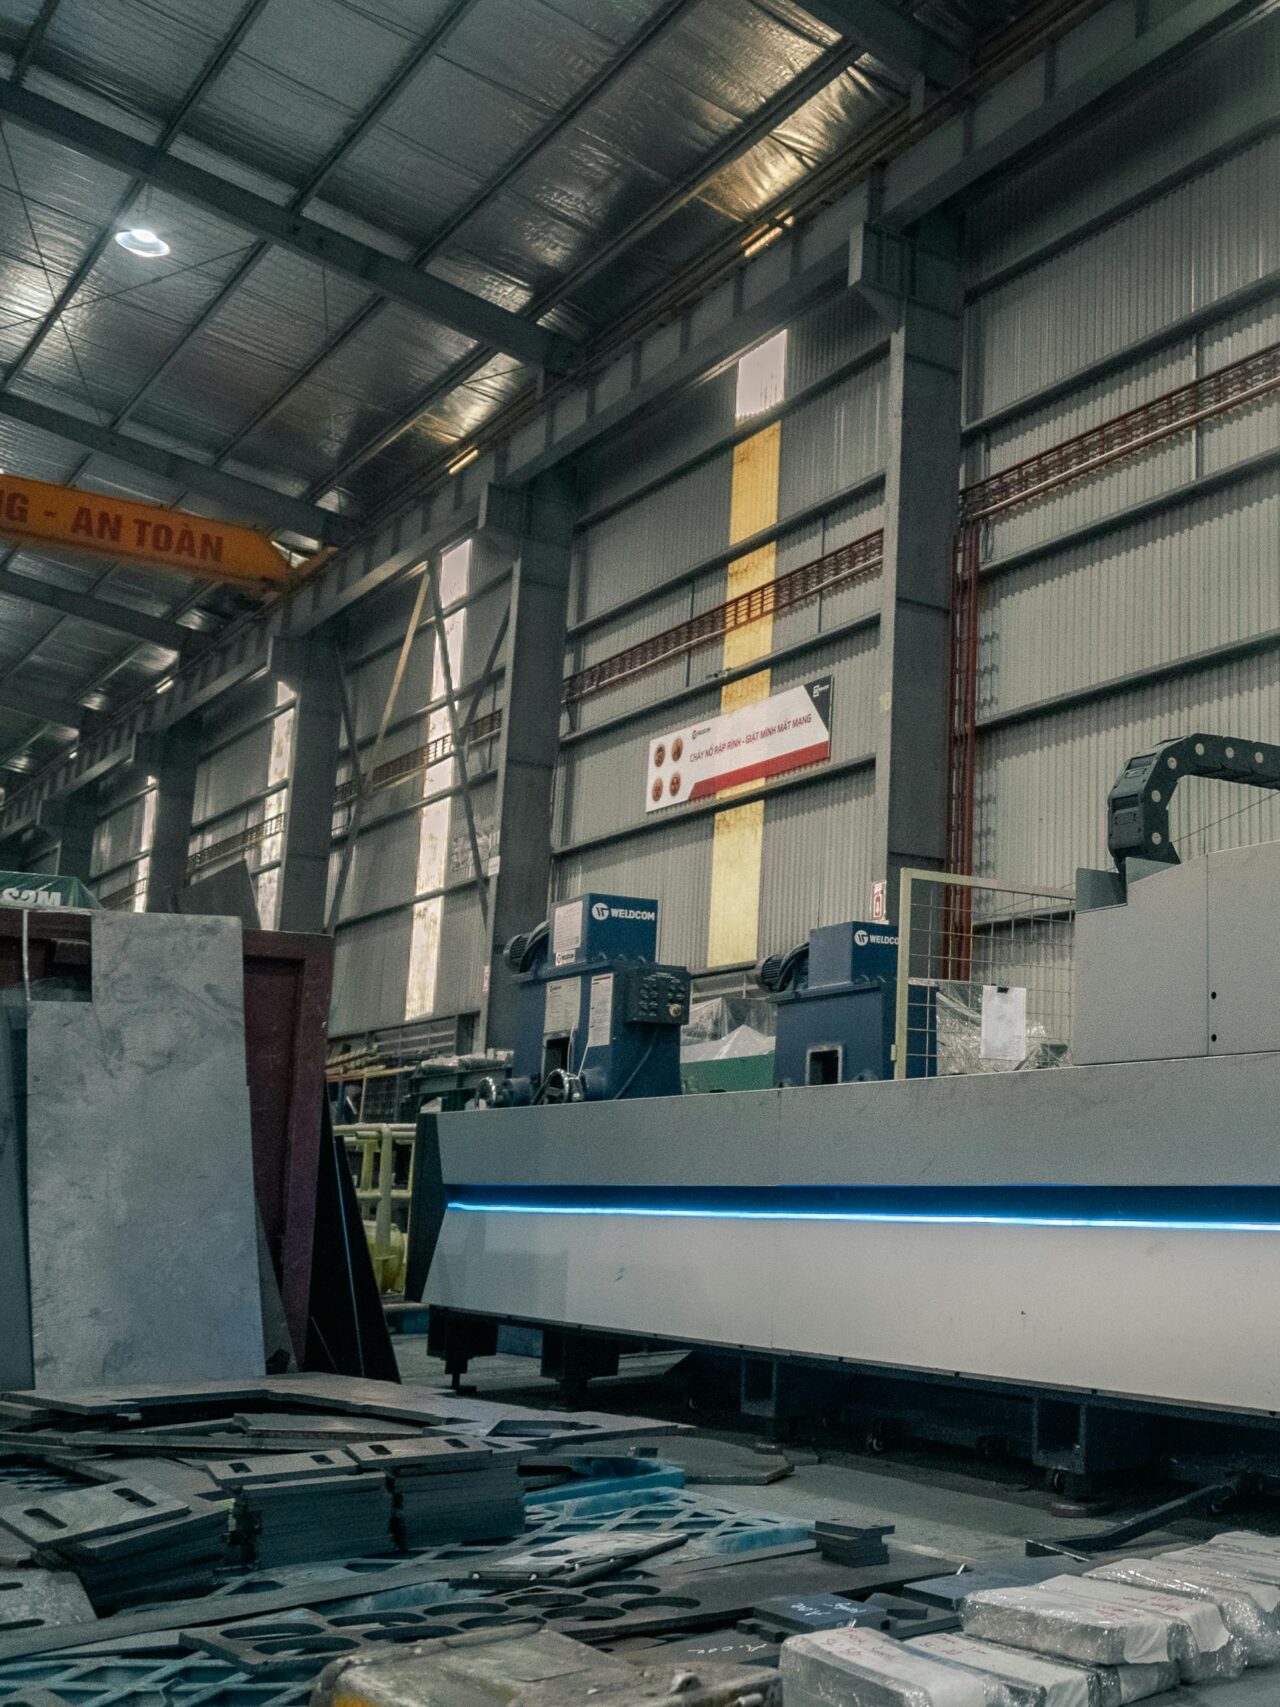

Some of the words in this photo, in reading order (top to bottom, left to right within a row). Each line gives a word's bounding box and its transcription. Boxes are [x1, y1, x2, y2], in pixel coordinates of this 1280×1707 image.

[70, 506, 122, 542] AN
[133, 518, 224, 563] TOÀN
[610, 907, 656, 921] WELDCOM
